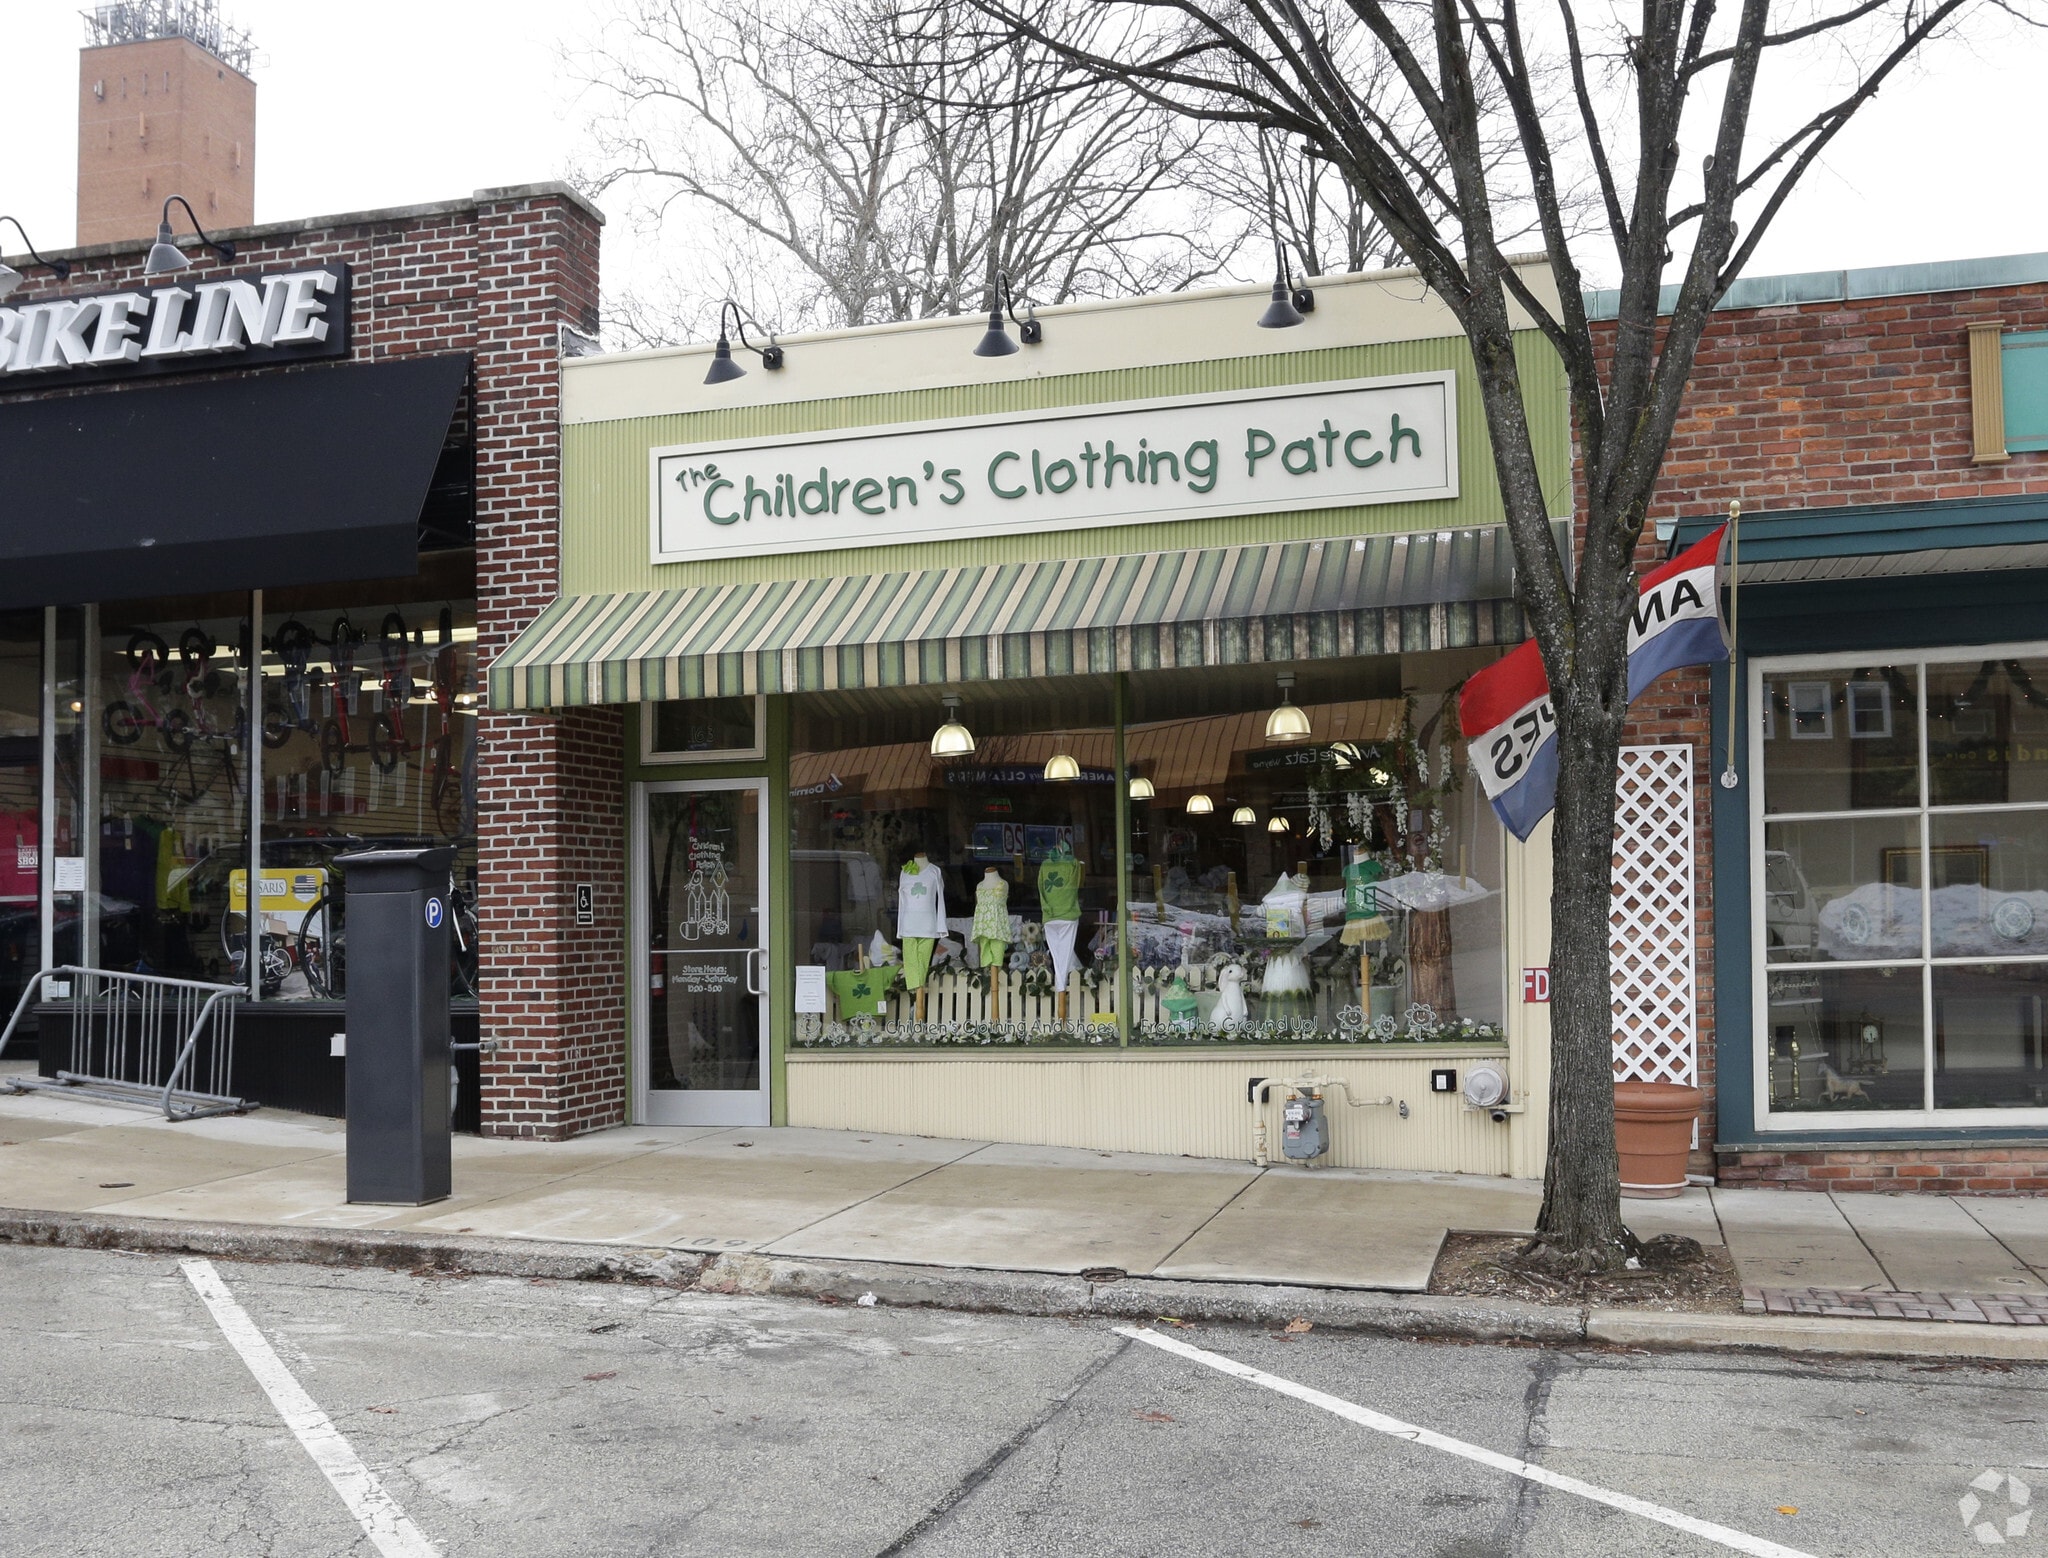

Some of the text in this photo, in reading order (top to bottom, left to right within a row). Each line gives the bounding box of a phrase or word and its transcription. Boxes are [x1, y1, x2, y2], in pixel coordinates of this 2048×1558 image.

[675, 413, 1422, 525] The Children's Clothing Patch
[692, 842, 725, 852] Children's
[17, 857, 38, 865] SHO
[689, 851, 720, 861] Clothing
[682, 964, 703, 973] Store
[885, 1015, 1319, 1036] Children's Clothing And Shoes From The Ground Up!
